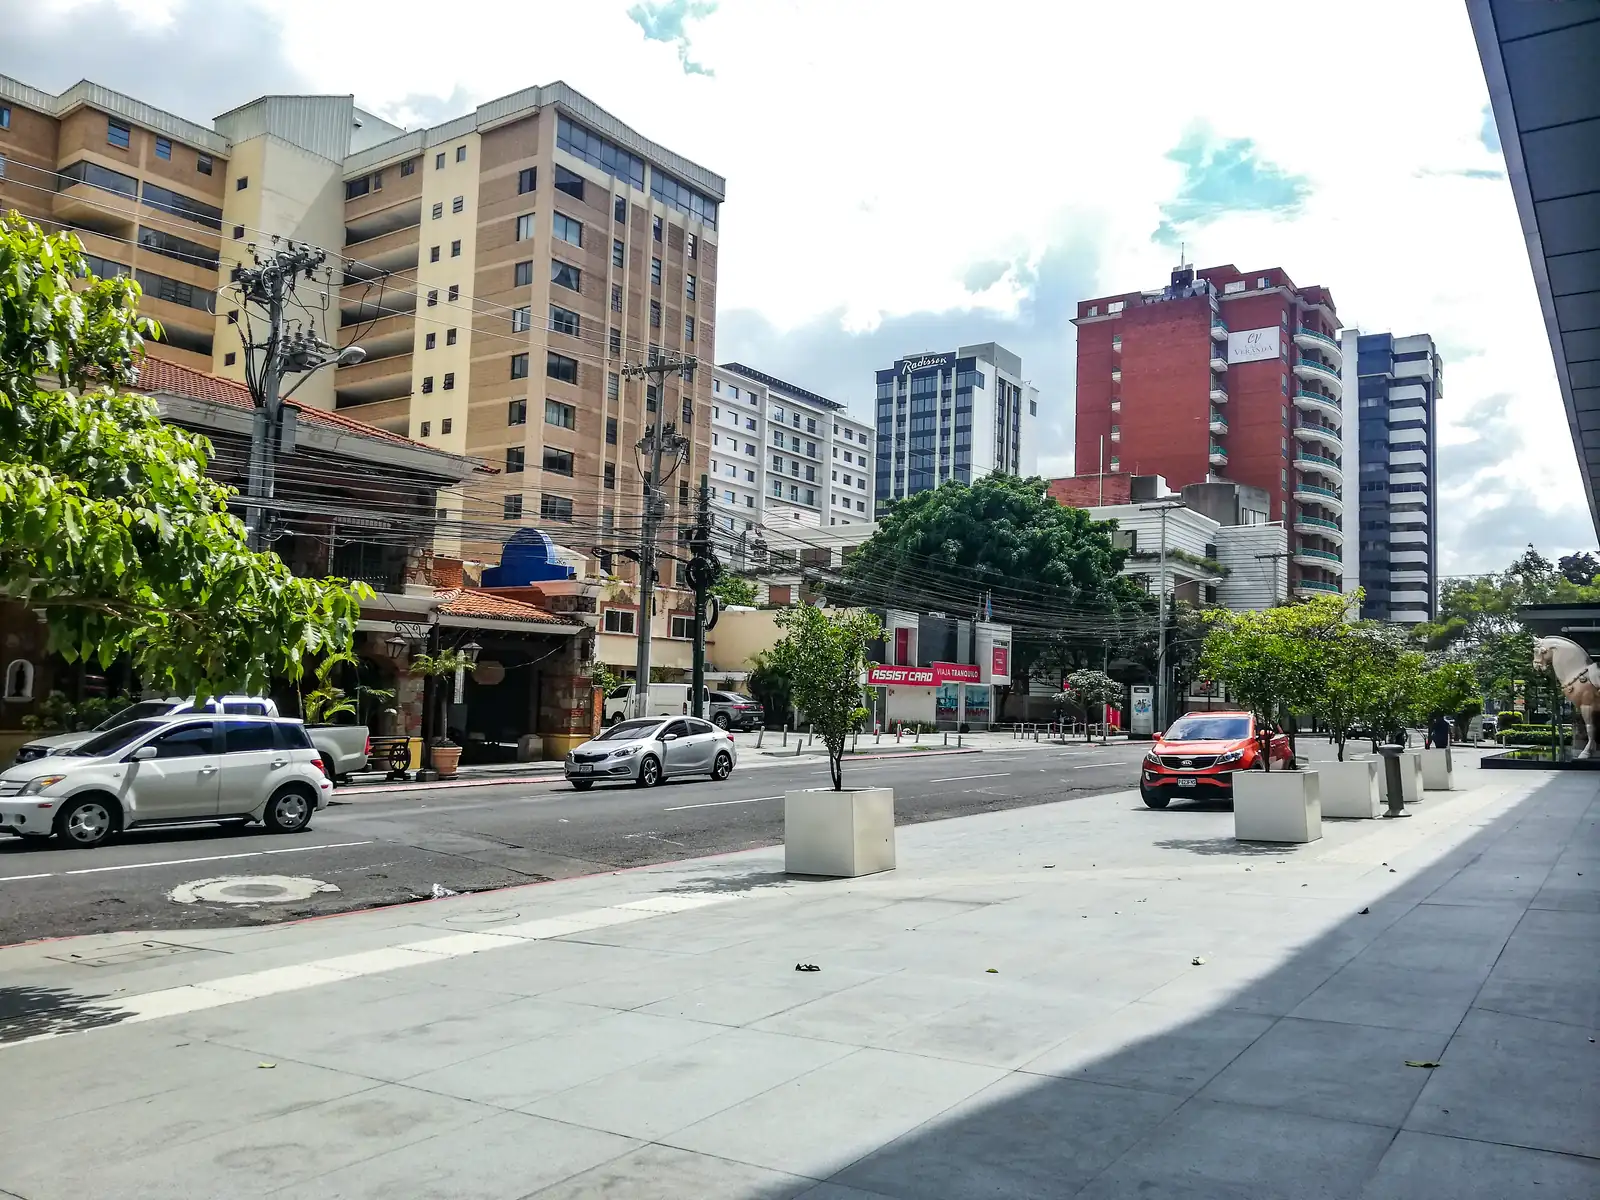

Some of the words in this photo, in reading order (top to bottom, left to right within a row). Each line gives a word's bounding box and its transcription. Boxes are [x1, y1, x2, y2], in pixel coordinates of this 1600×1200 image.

[901, 355, 947, 375] Radisson
[871, 669, 908, 681] ASSIST
[908, 671, 933, 682] CARD
[936, 667, 951, 676] VIAJA
[951, 669, 979, 678] TRANQUILO
